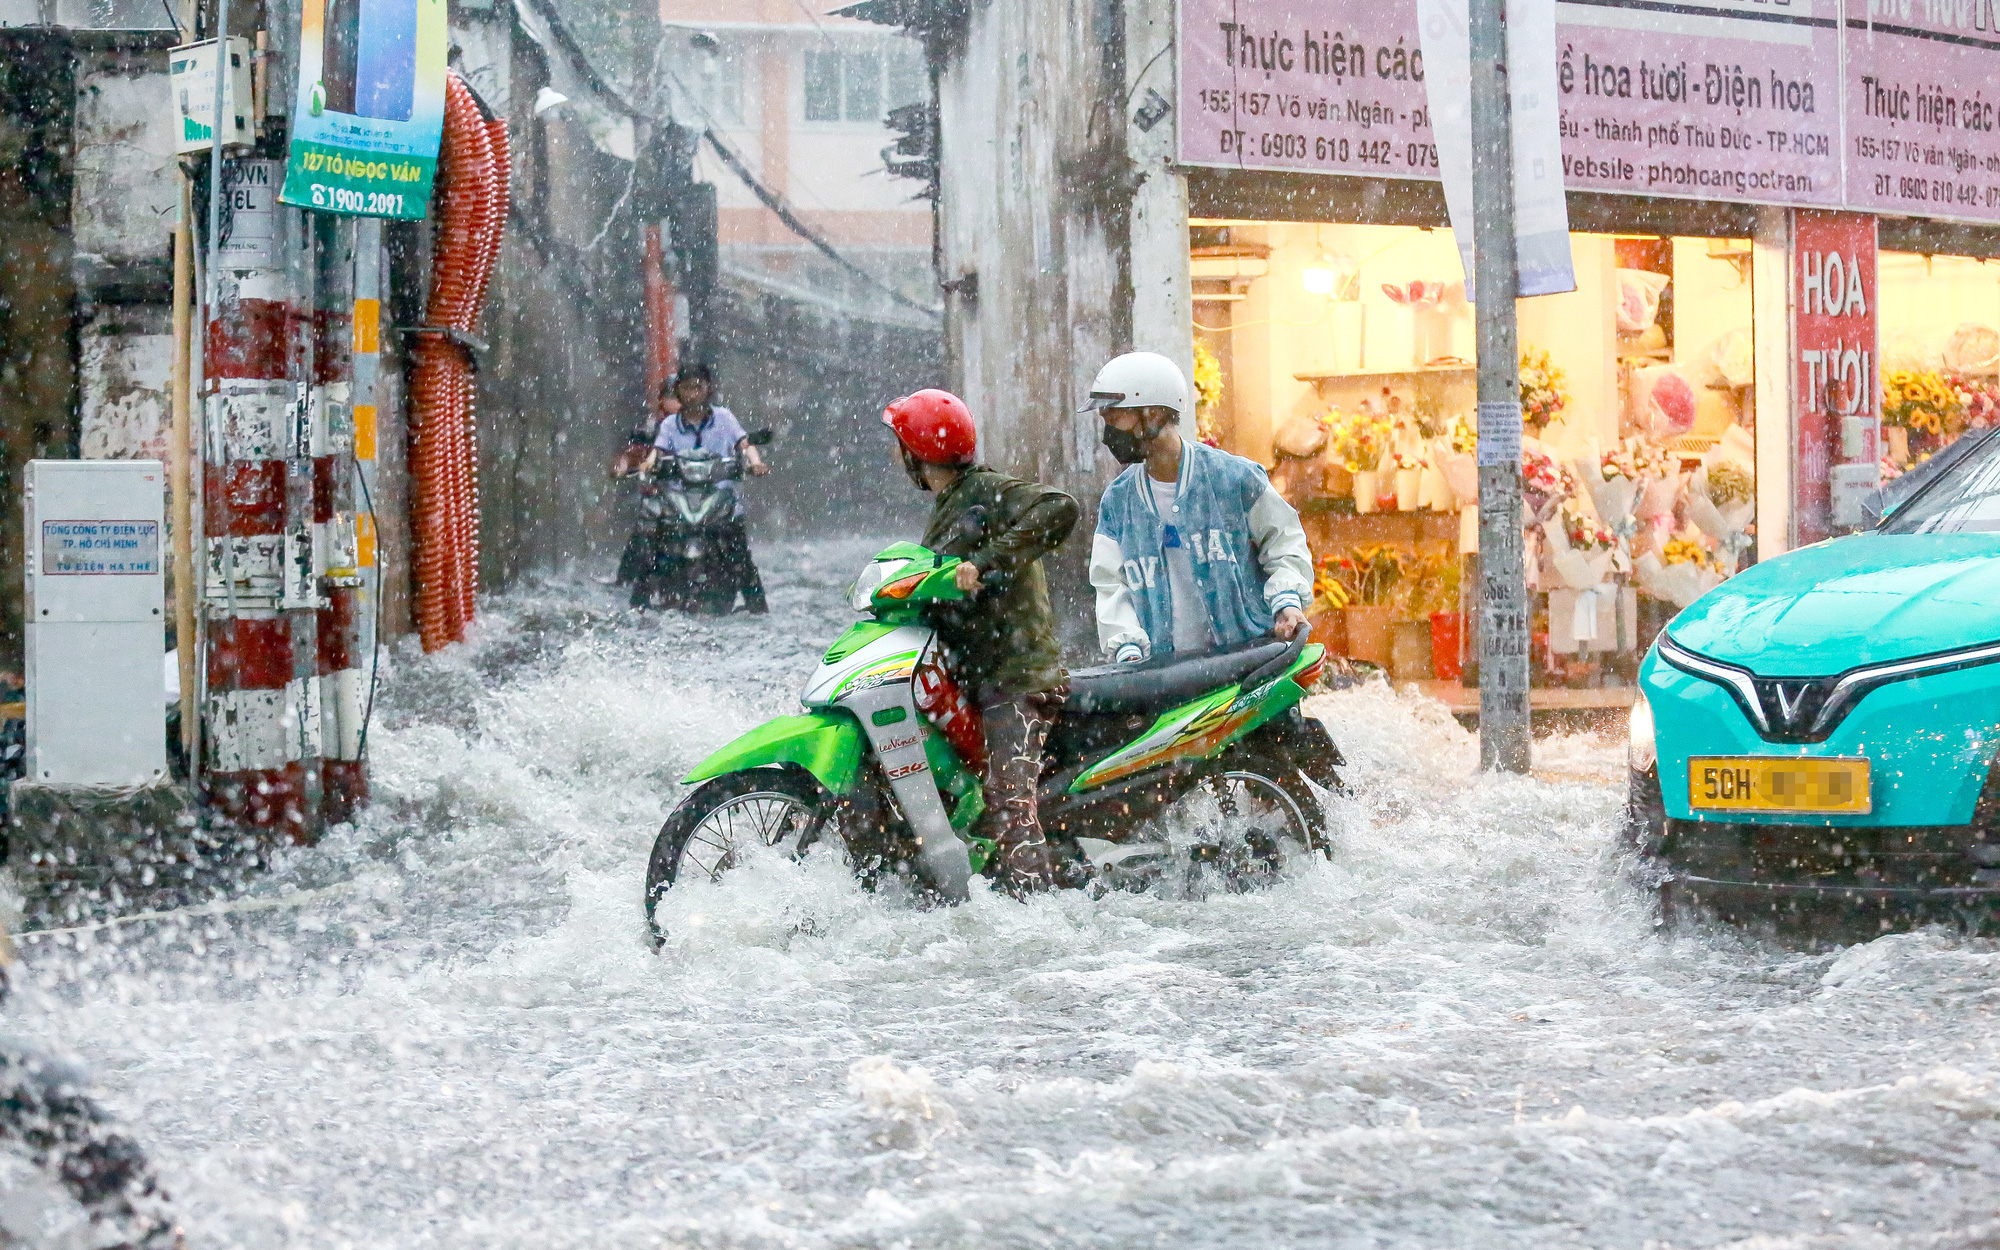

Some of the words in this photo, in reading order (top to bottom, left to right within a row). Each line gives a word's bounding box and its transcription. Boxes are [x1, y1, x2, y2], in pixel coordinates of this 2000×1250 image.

[1219, 22, 1295, 79] Thực
[1303, 30, 1366, 86] hiện
[1376, 36, 1425, 82] các
[1584, 53, 1632, 98] hoa
[1640, 61, 1687, 104] tươi
[1705, 63, 1762, 117] Điện
[1770, 68, 1815, 114] hoa
[1861, 75, 1910, 129] Thực
[1916, 83, 1956, 133] hiện
[1962, 89, 1993, 132] các
[1276, 93, 1301, 119] Võ
[1346, 99, 1395, 130] Ngân
[1261, 132, 1307, 159] 0903
[1315, 136, 1350, 163] 610
[1358, 139, 1391, 165] 442
[1593, 118, 1642, 142] thành
[1648, 120, 1680, 149] phố
[1766, 130, 1829, 157] TP.HCM
[302, 151, 324, 172] 127
[326, 152, 344, 175] TÔ
[344, 157, 389, 184] NGỌC
[328, 186, 404, 216] 1900.2091
[1803, 250, 1867, 317] HOA
[1802, 336, 1870, 414] TƯƠI
[62, 539, 77, 549] TP.
[94, 537, 111, 549] CHÍ
[113, 539, 138, 549] MINH
[72, 523, 98, 535] CÔNG
[100, 525, 111, 535] TY
